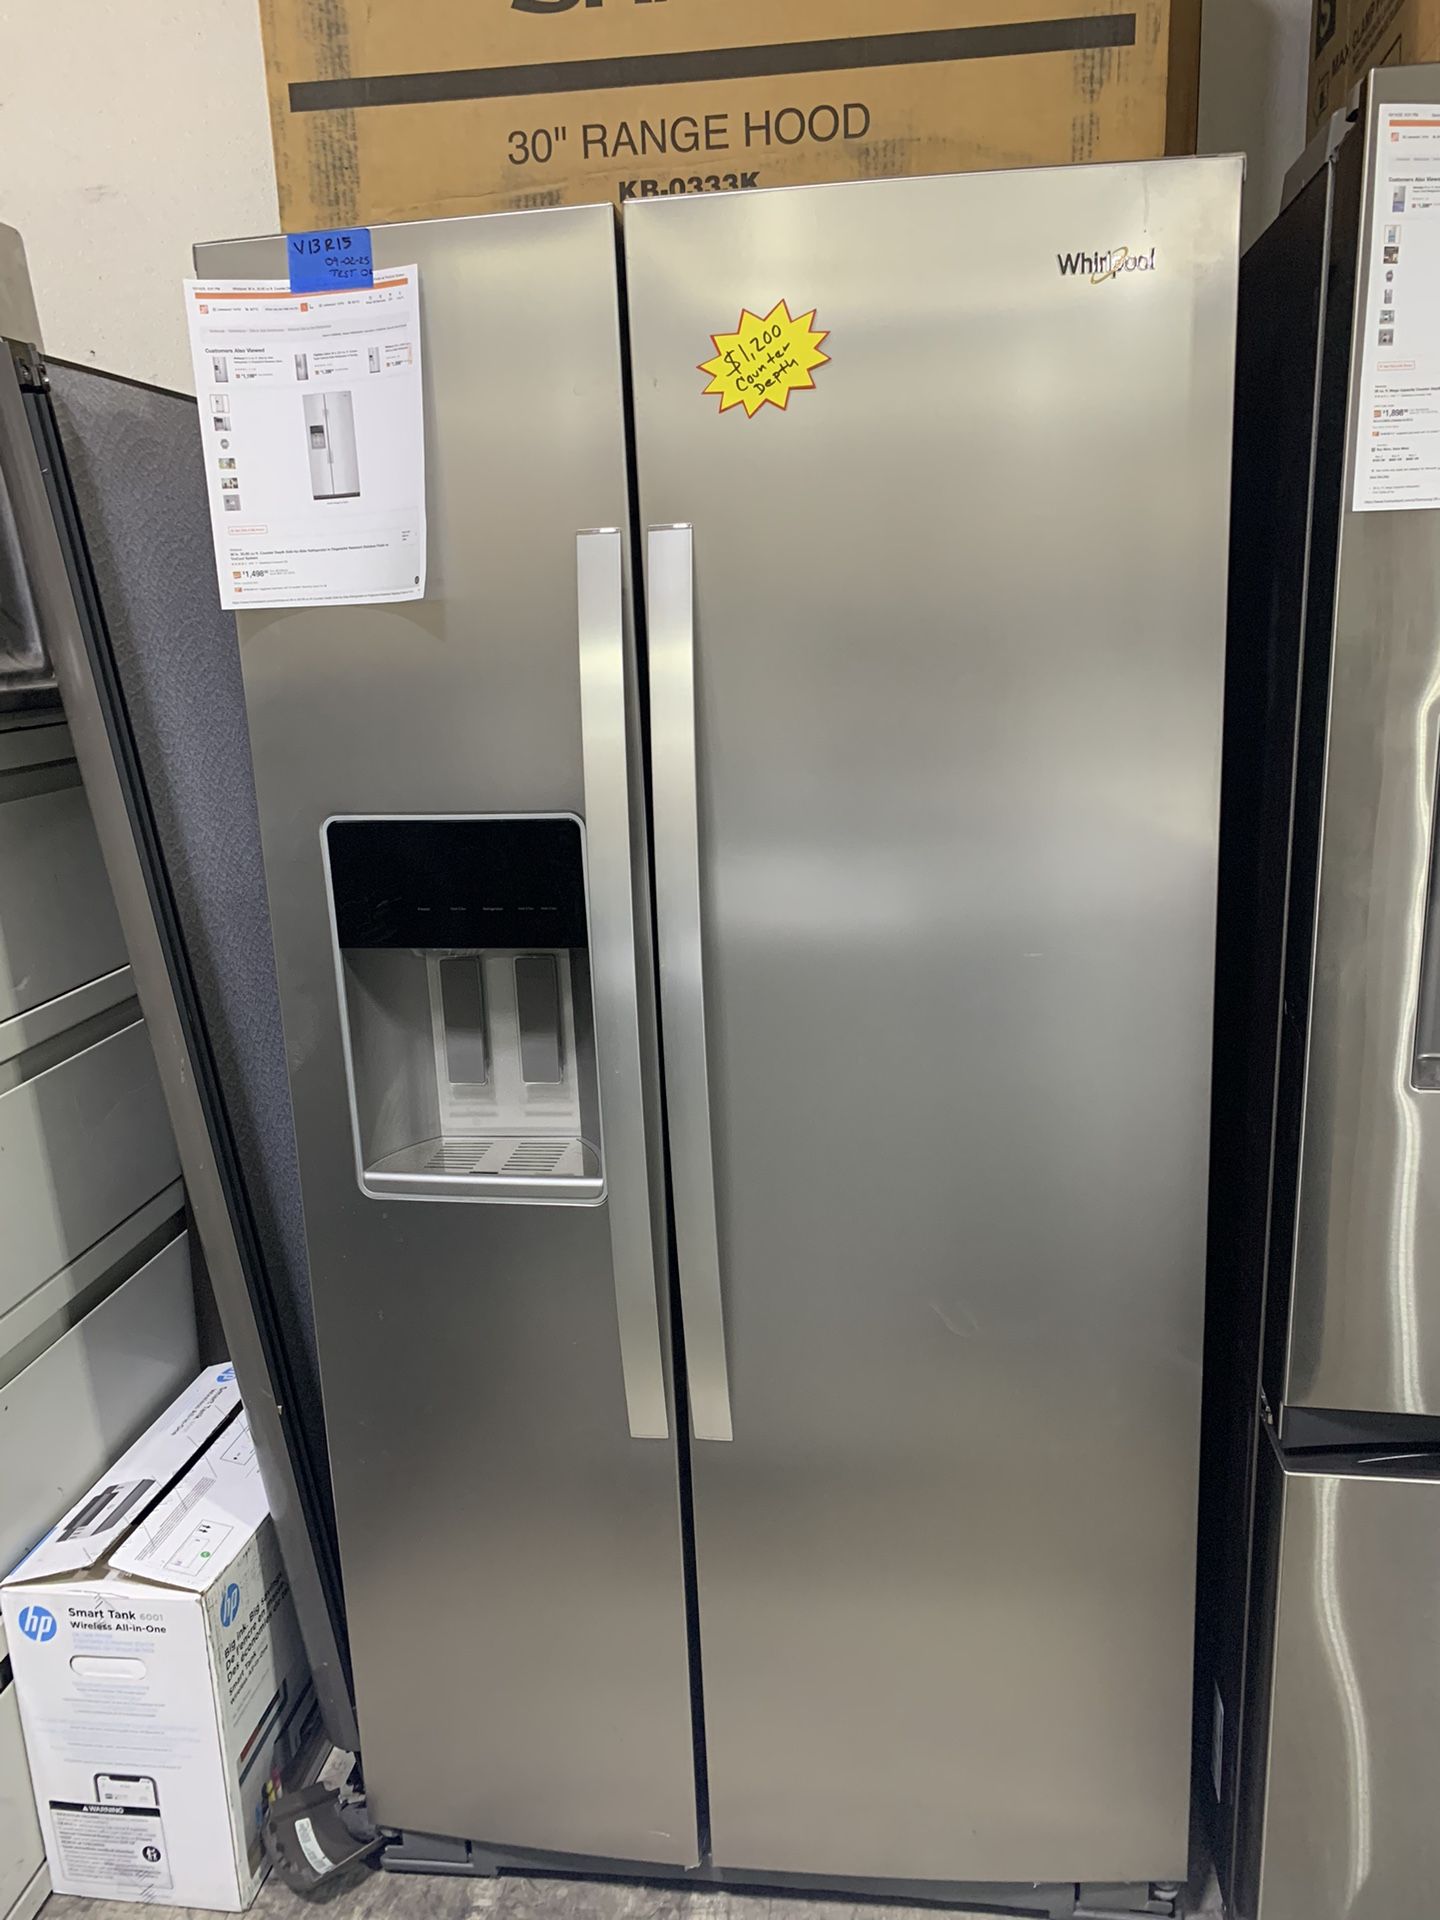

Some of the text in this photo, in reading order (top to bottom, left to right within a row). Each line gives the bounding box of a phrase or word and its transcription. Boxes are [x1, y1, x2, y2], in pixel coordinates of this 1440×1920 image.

[507, 102, 871, 165] 30" RANGE HOOD
[329, 268, 357, 278] TEST
[1057, 247, 1155, 280] Whirlpool
[723, 324, 782, 377] $1,200
[21, 1605, 55, 1642] hp
[68, 1607, 164, 1622] Smart Tank 6001
[70, 1621, 167, 1634] Wireless All-in-One
